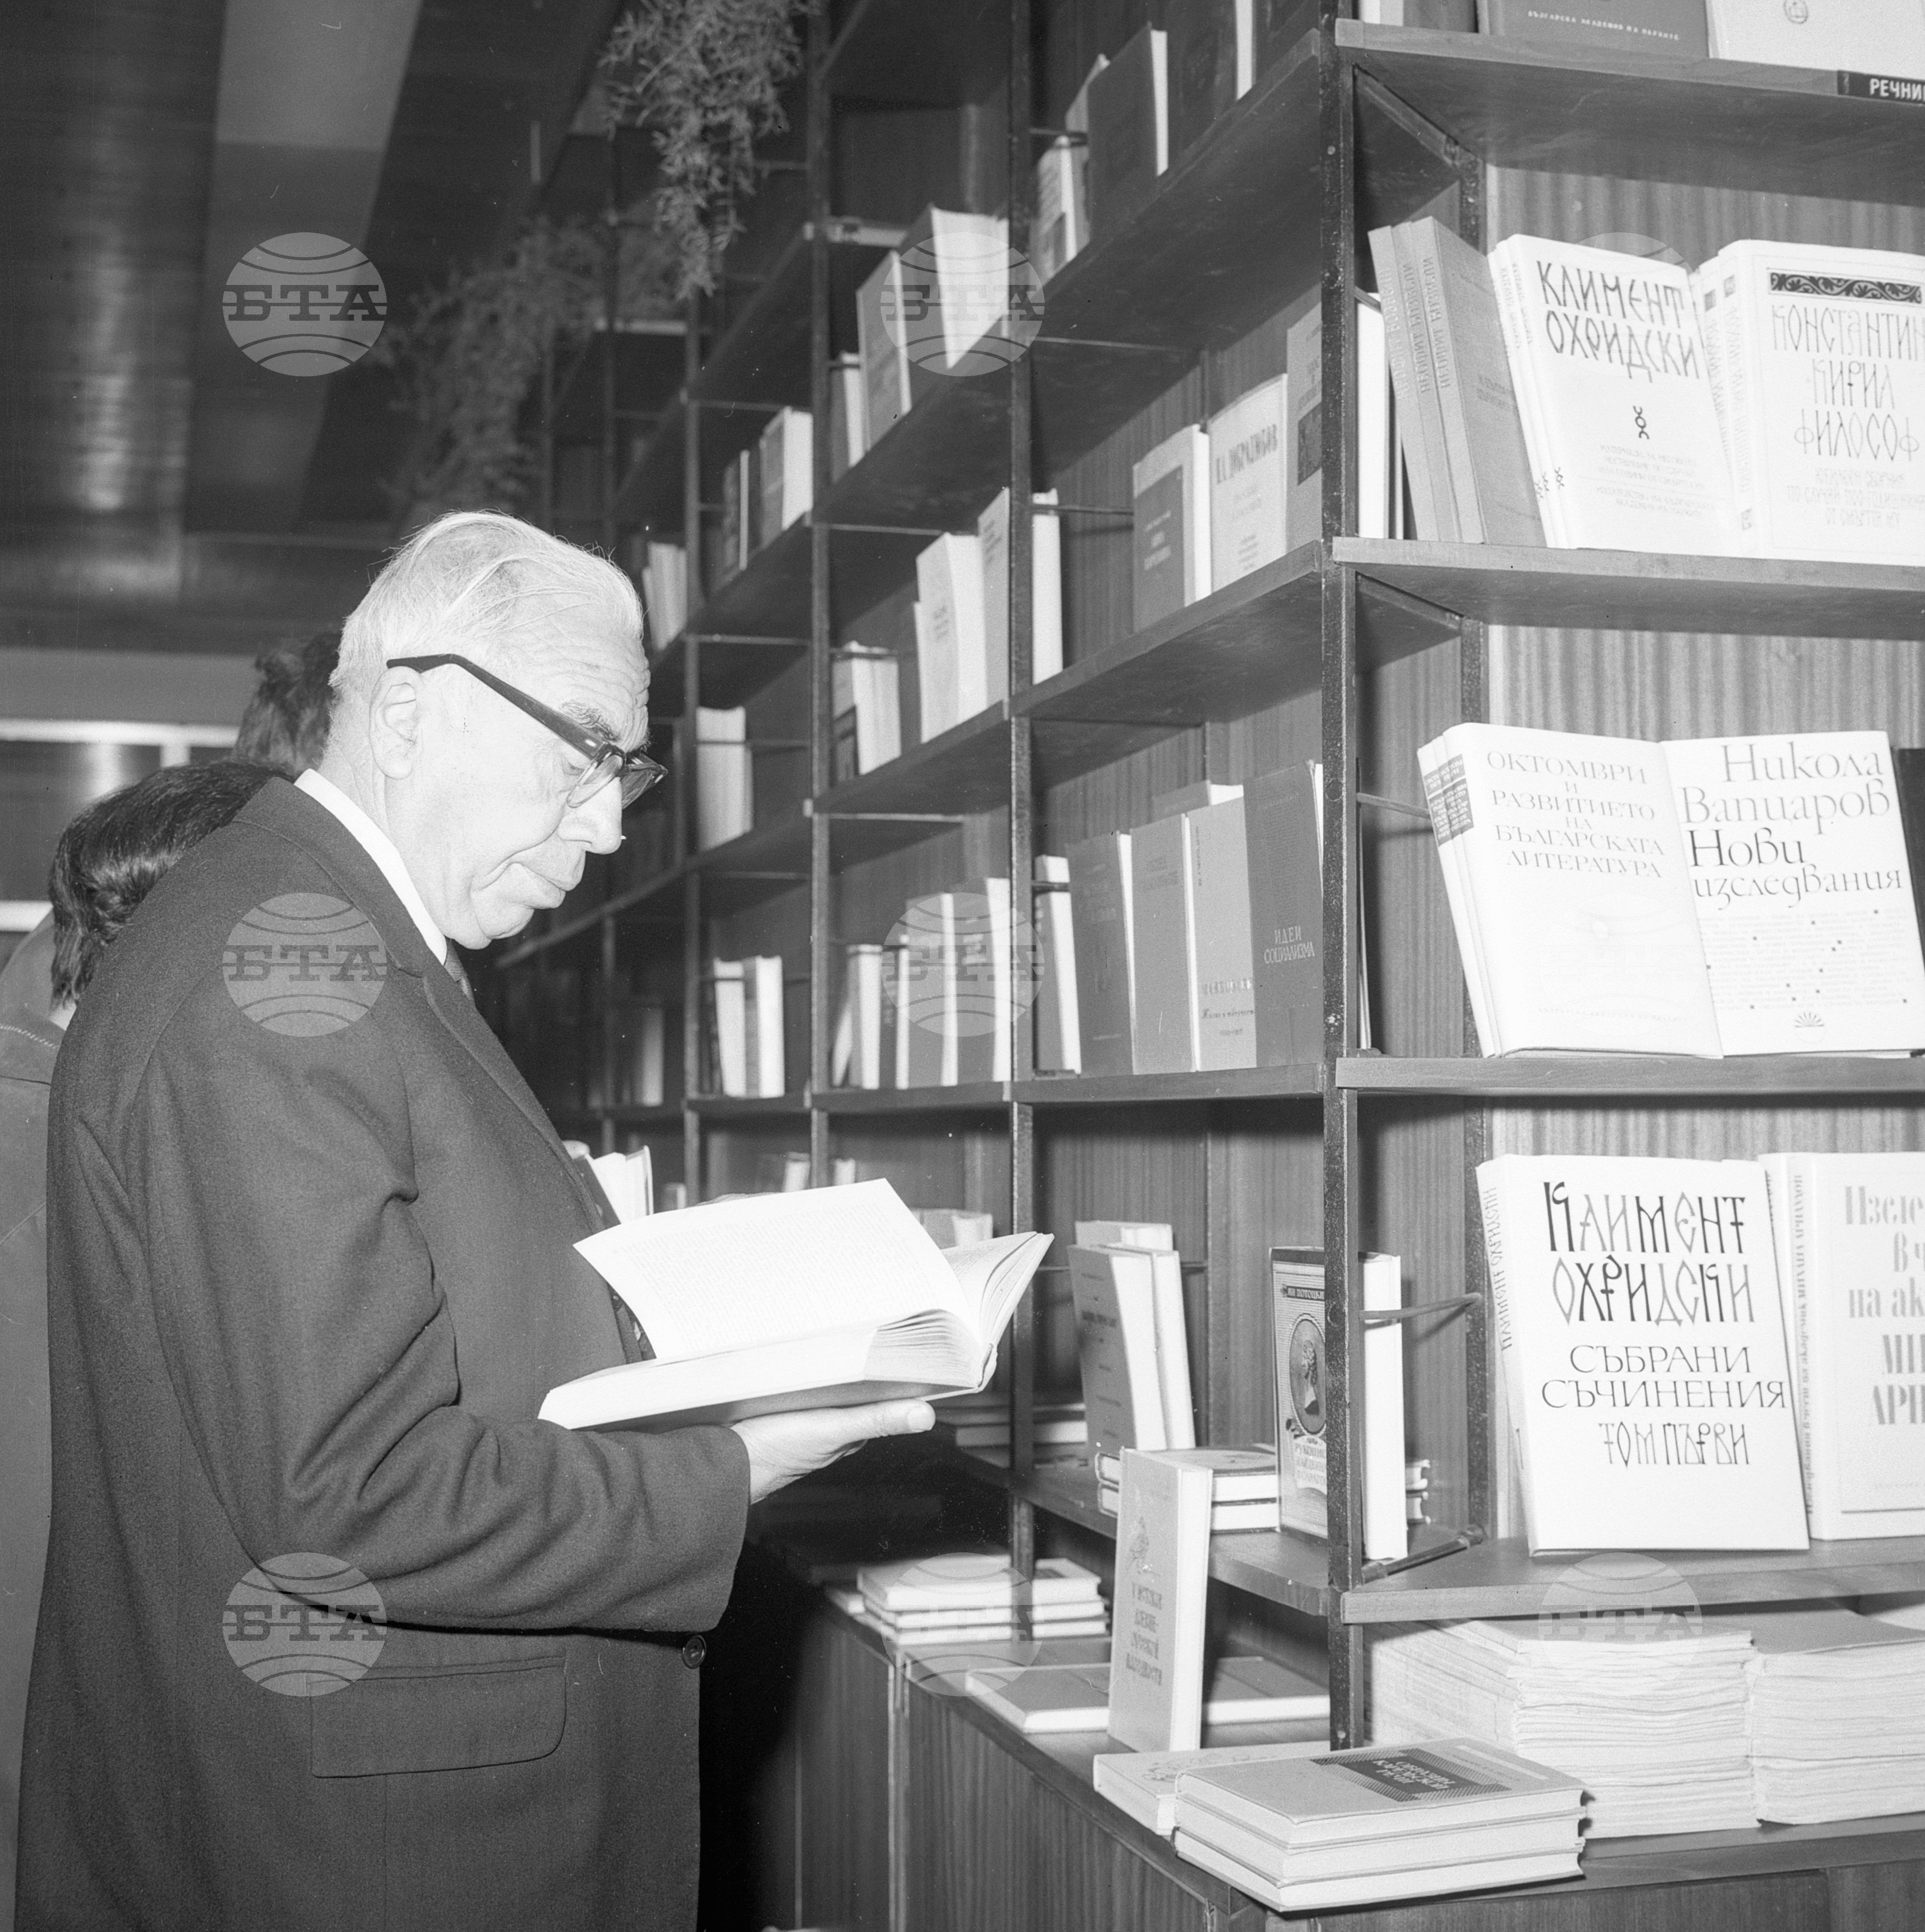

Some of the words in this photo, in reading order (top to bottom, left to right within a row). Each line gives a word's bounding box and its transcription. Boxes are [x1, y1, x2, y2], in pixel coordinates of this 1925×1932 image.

[1869, 77, 1925, 102] РЕЧНИ
[1536, 260, 1685, 329] КЛИМЕНТ
[1545, 310, 1700, 384] ОХРИДСКИ
[1812, 358, 1895, 409] КИРИЛ
[1794, 409, 1920, 462] ФИЛОСОФ
[1487, 751, 1648, 784] ОКТОМВРИ
[1721, 741, 1884, 782] Никола
[1565, 781, 1579, 794] И
[1492, 790, 1655, 820] РАЗВИТИЕТО
[1681, 778, 1890, 835] Вапцаров
[1566, 816, 1593, 830] НА
[1494, 825, 1665, 855] БЪЛГАРСКАТА
[1689, 827, 1806, 867] Нови
[1506, 850, 1661, 878] ЛИТЕРАТУРА
[1694, 864, 1902, 910] изследвания
[1274, 925, 1302, 945] ИДЕИ
[1264, 941, 1316, 964] СОЦИАЛИЗМА
[1543, 1181, 1746, 1254] КЛИМЕНТ
[1552, 1254, 1755, 1326] ОХРИДСКИ
[1849, 1288, 1882, 1319] на
[1570, 1345, 1751, 1374] СЪБРАНИ
[1542, 1379, 1788, 1408] СЪЧИНЕНИЯ
[1599, 1421, 1657, 1468] ТОМ
[1662, 1421, 1750, 1466] ПЪРВИ
